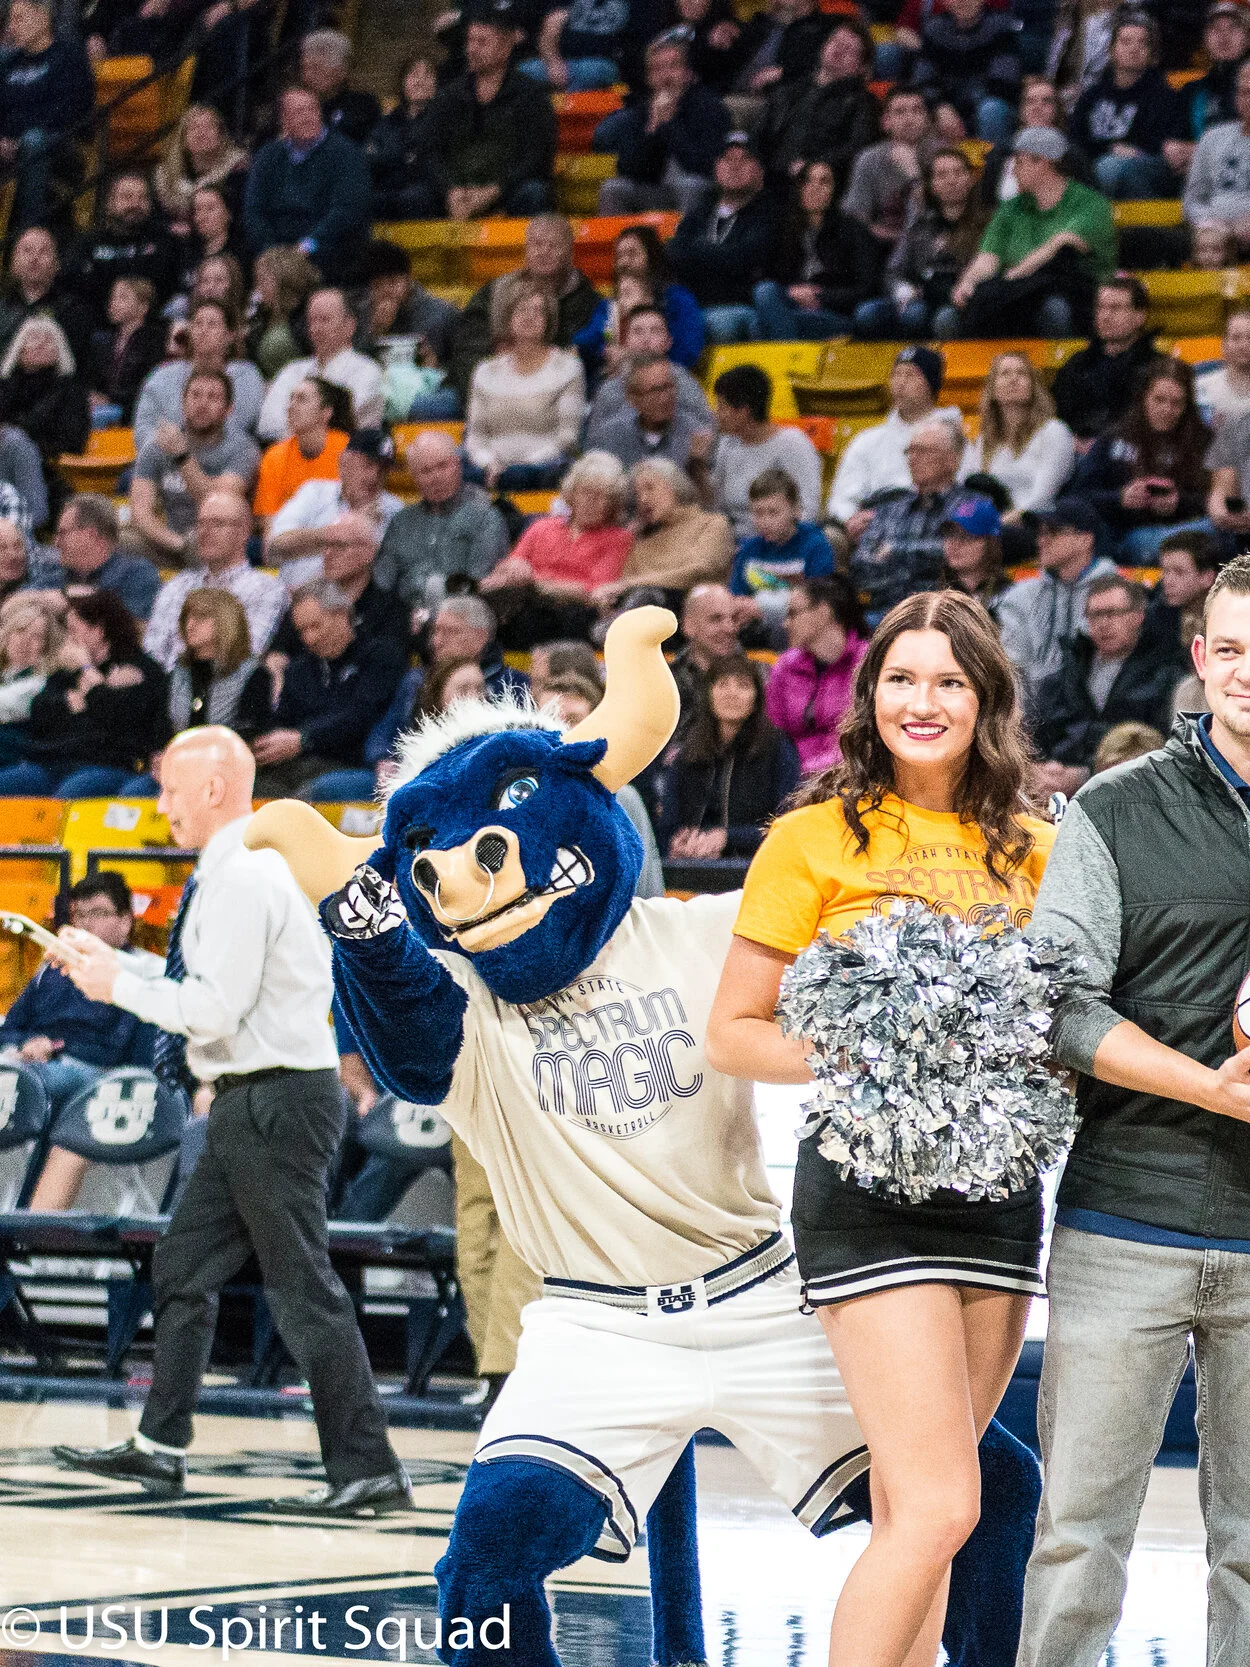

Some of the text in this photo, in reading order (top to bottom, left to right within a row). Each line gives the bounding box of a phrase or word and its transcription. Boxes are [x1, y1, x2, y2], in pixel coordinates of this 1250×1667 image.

[907, 848, 937, 864] UTAH
[577, 979, 625, 997] STATE
[526, 988, 689, 1052] SPECTRUM
[532, 1029, 704, 1116] MAGIC
[584, 1111, 656, 1136] BASKETBALL
